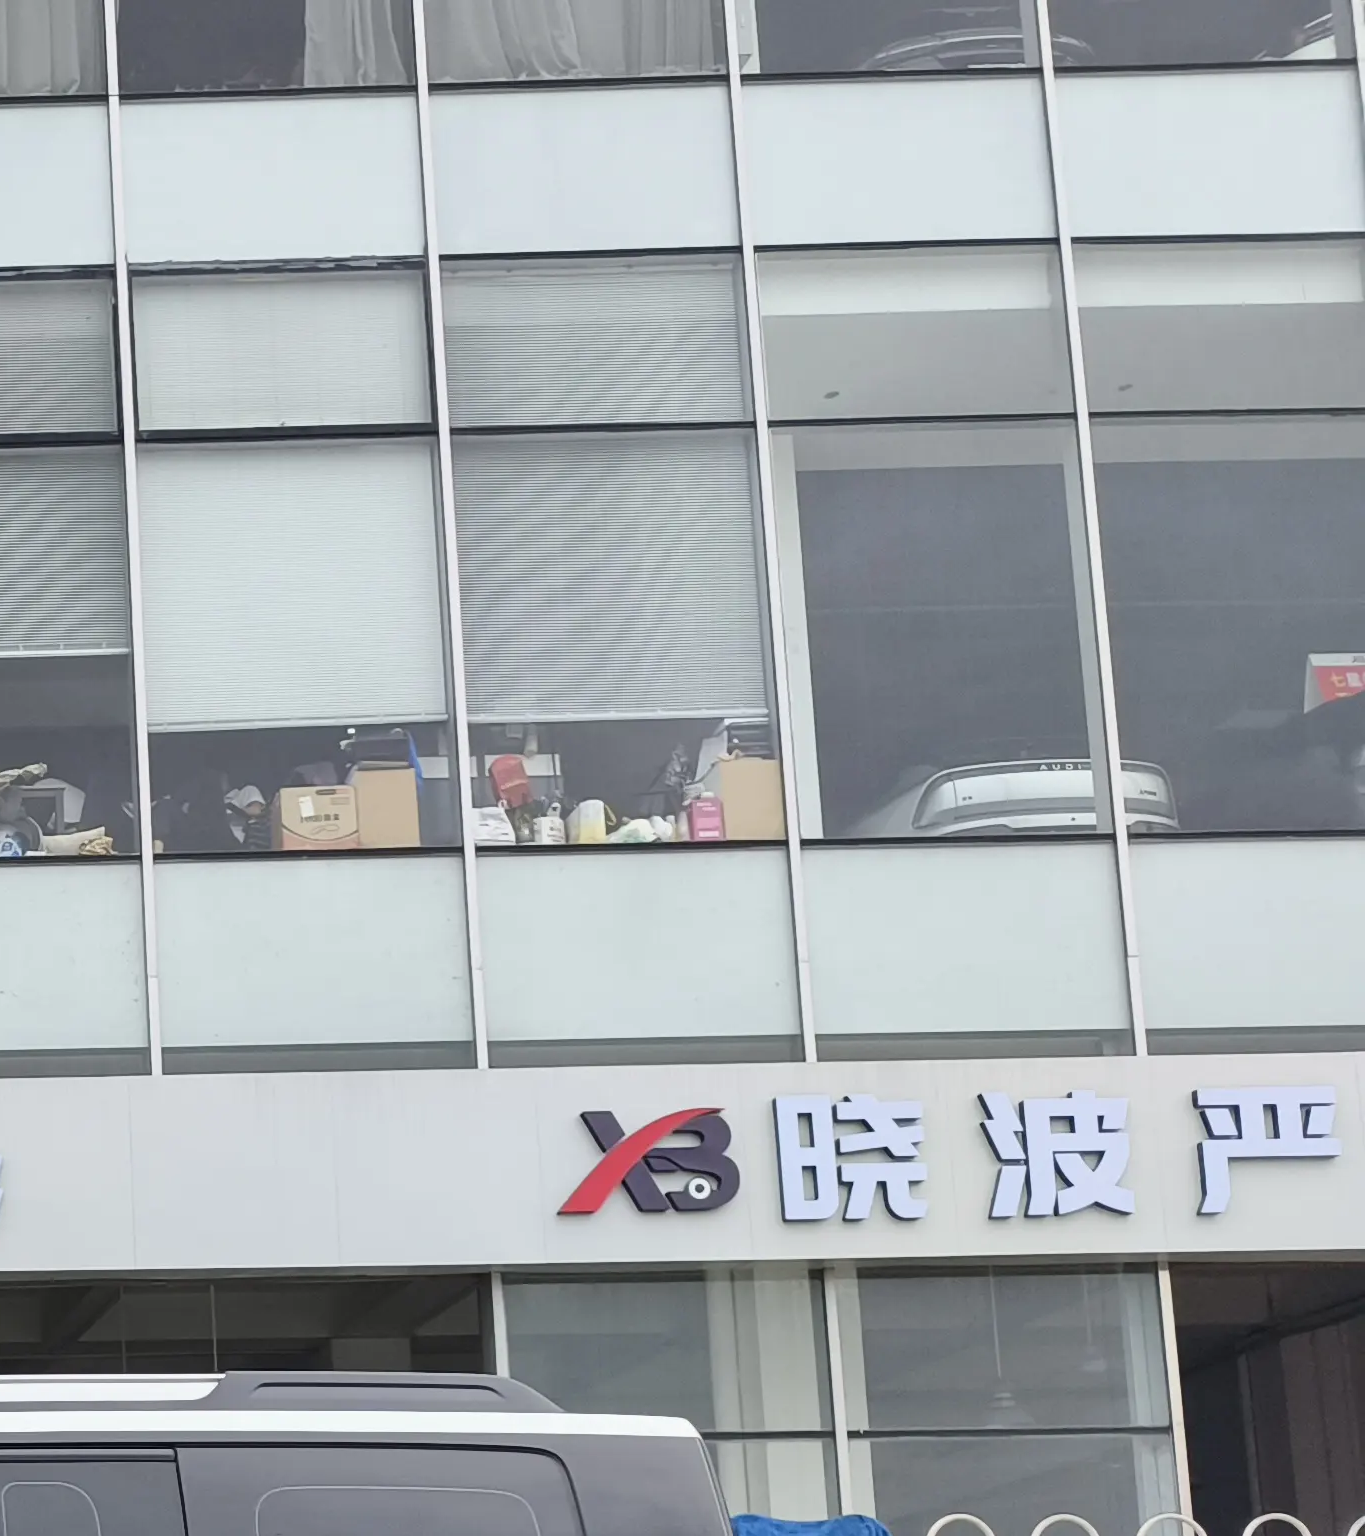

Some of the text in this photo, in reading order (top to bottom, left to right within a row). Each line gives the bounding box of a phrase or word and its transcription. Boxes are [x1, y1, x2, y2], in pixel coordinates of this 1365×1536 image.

[1039, 763, 1082, 771] AUDI
[771, 1085, 1343, 1224] 晓波严
